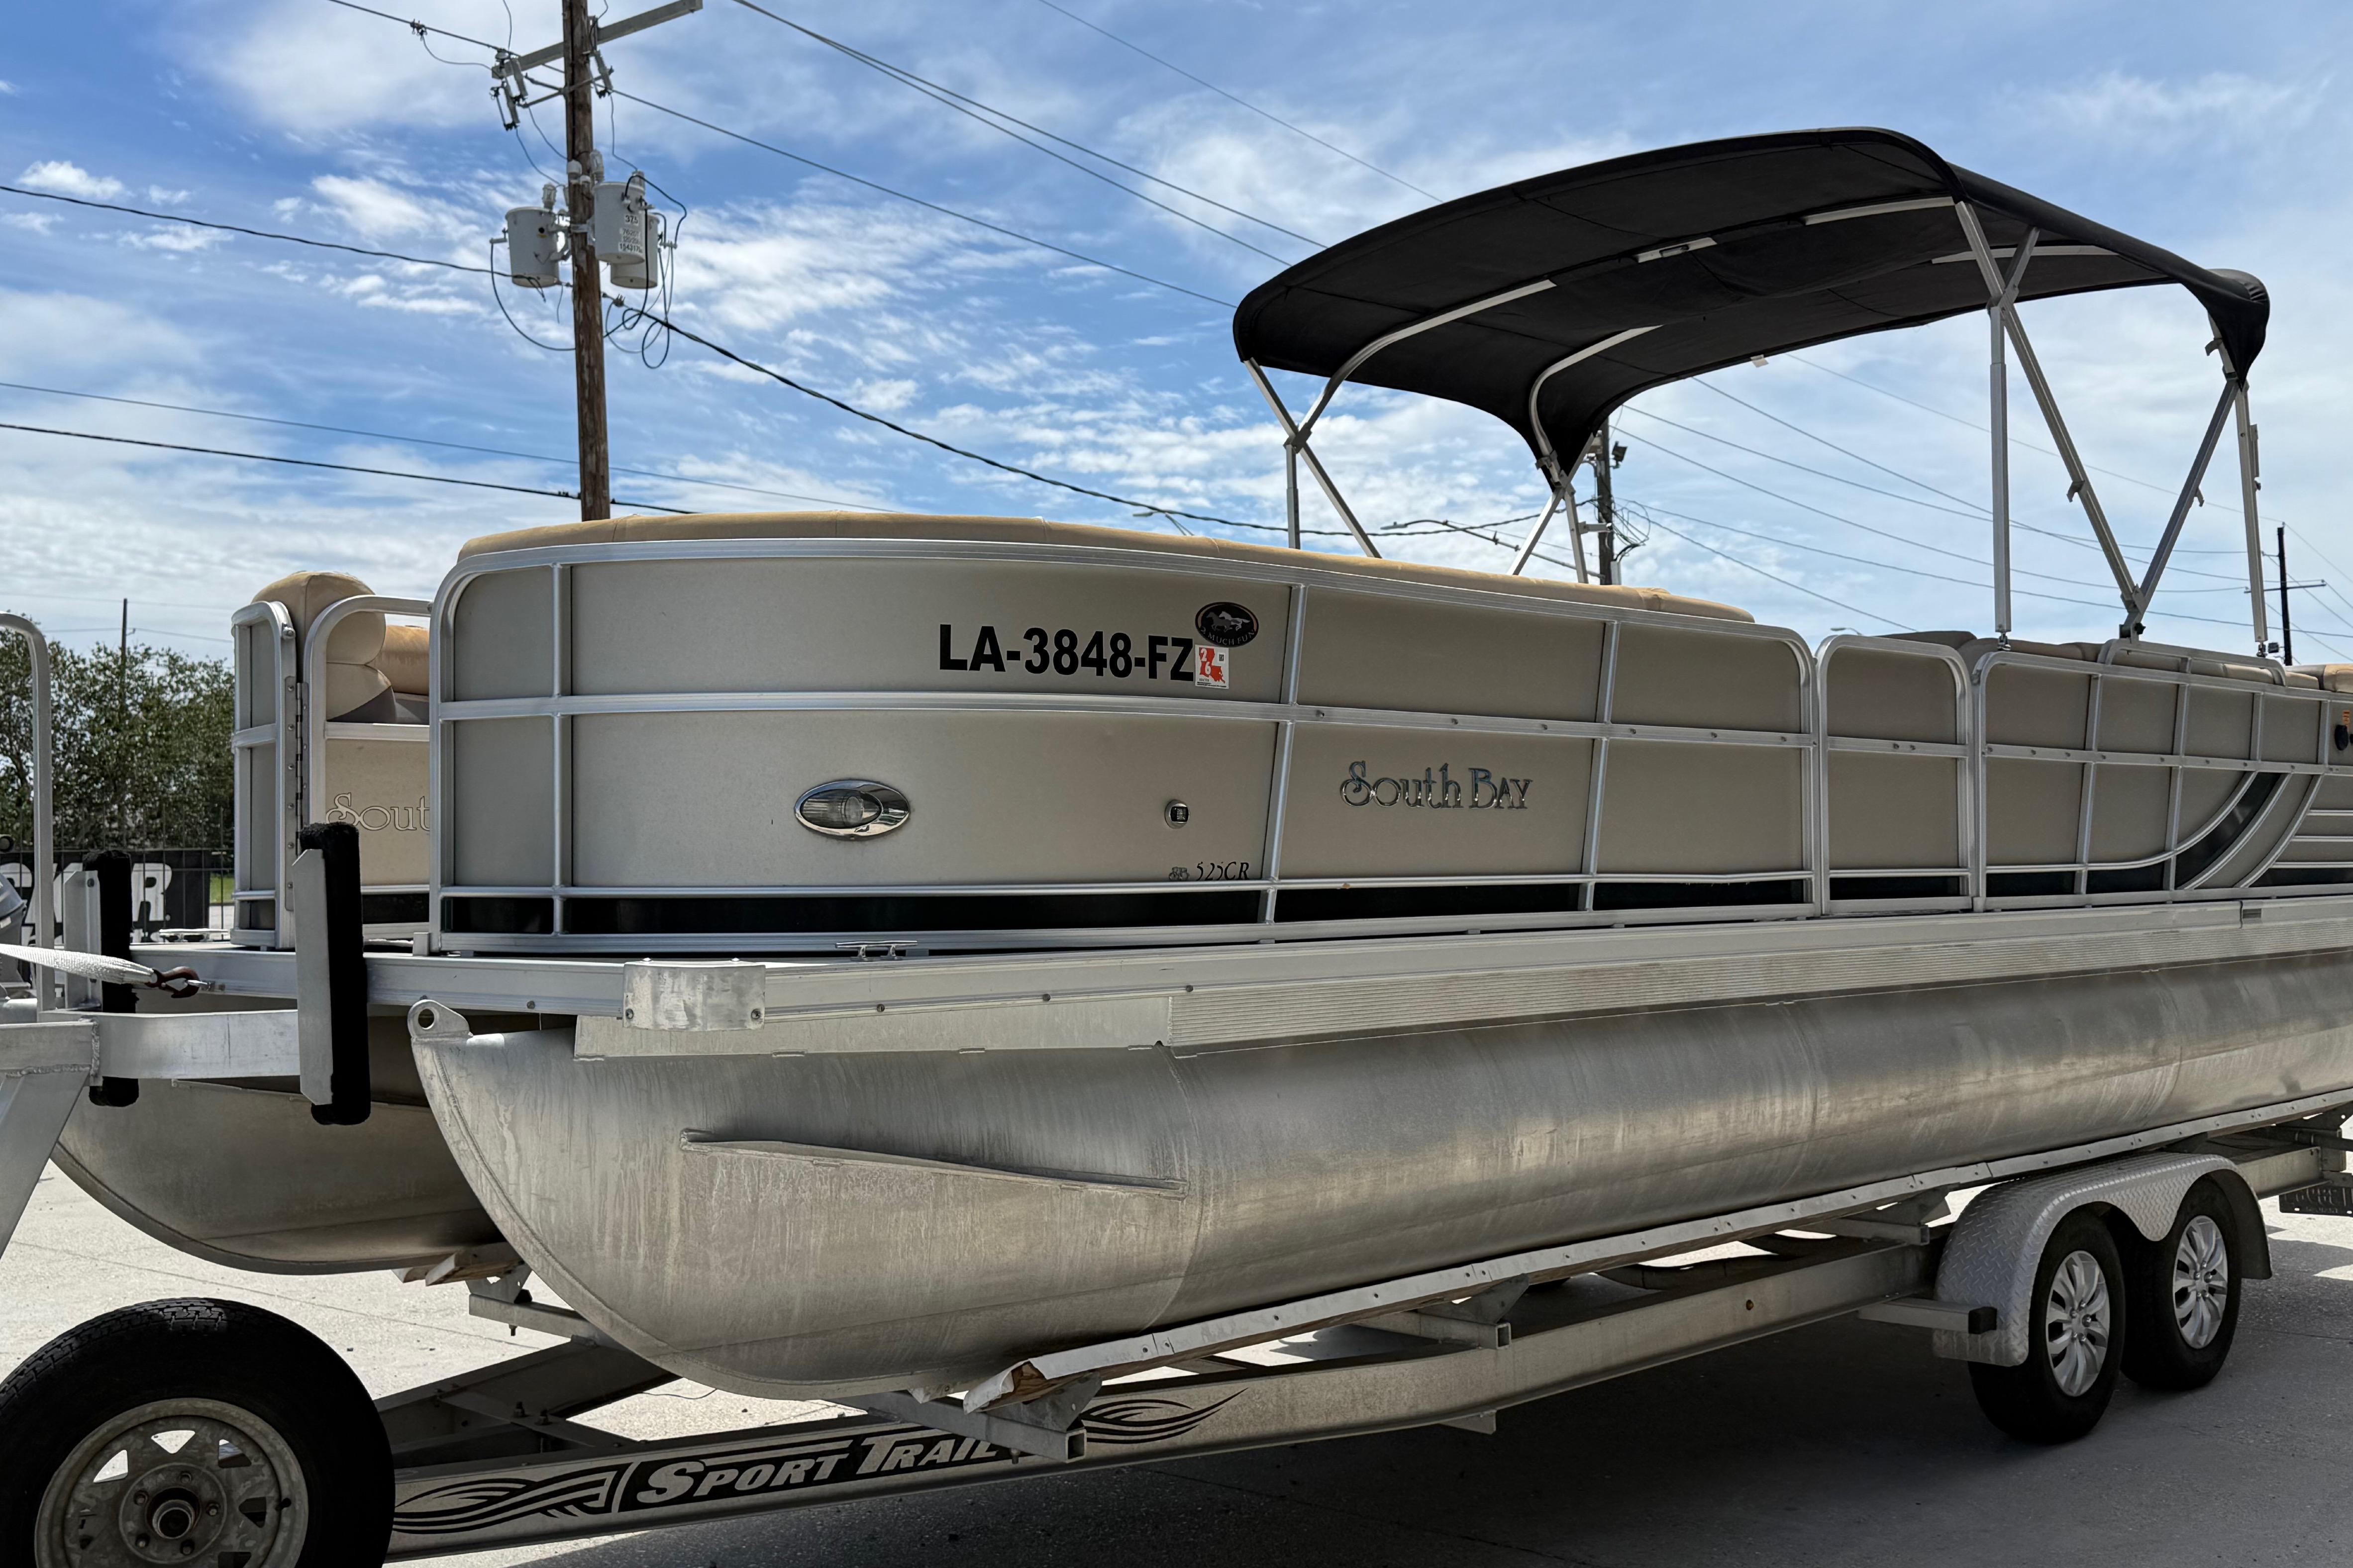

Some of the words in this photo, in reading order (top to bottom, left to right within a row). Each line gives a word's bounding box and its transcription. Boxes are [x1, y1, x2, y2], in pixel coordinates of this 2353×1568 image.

[1208, 632, 1234, 645] MUCH
[1237, 629, 1254, 644] FUN
[940, 624, 1194, 682] LA-3848-FZ
[1201, 648, 1207, 662] 2
[1205, 661, 1211, 675] 6
[1340, 761, 1464, 809] South
